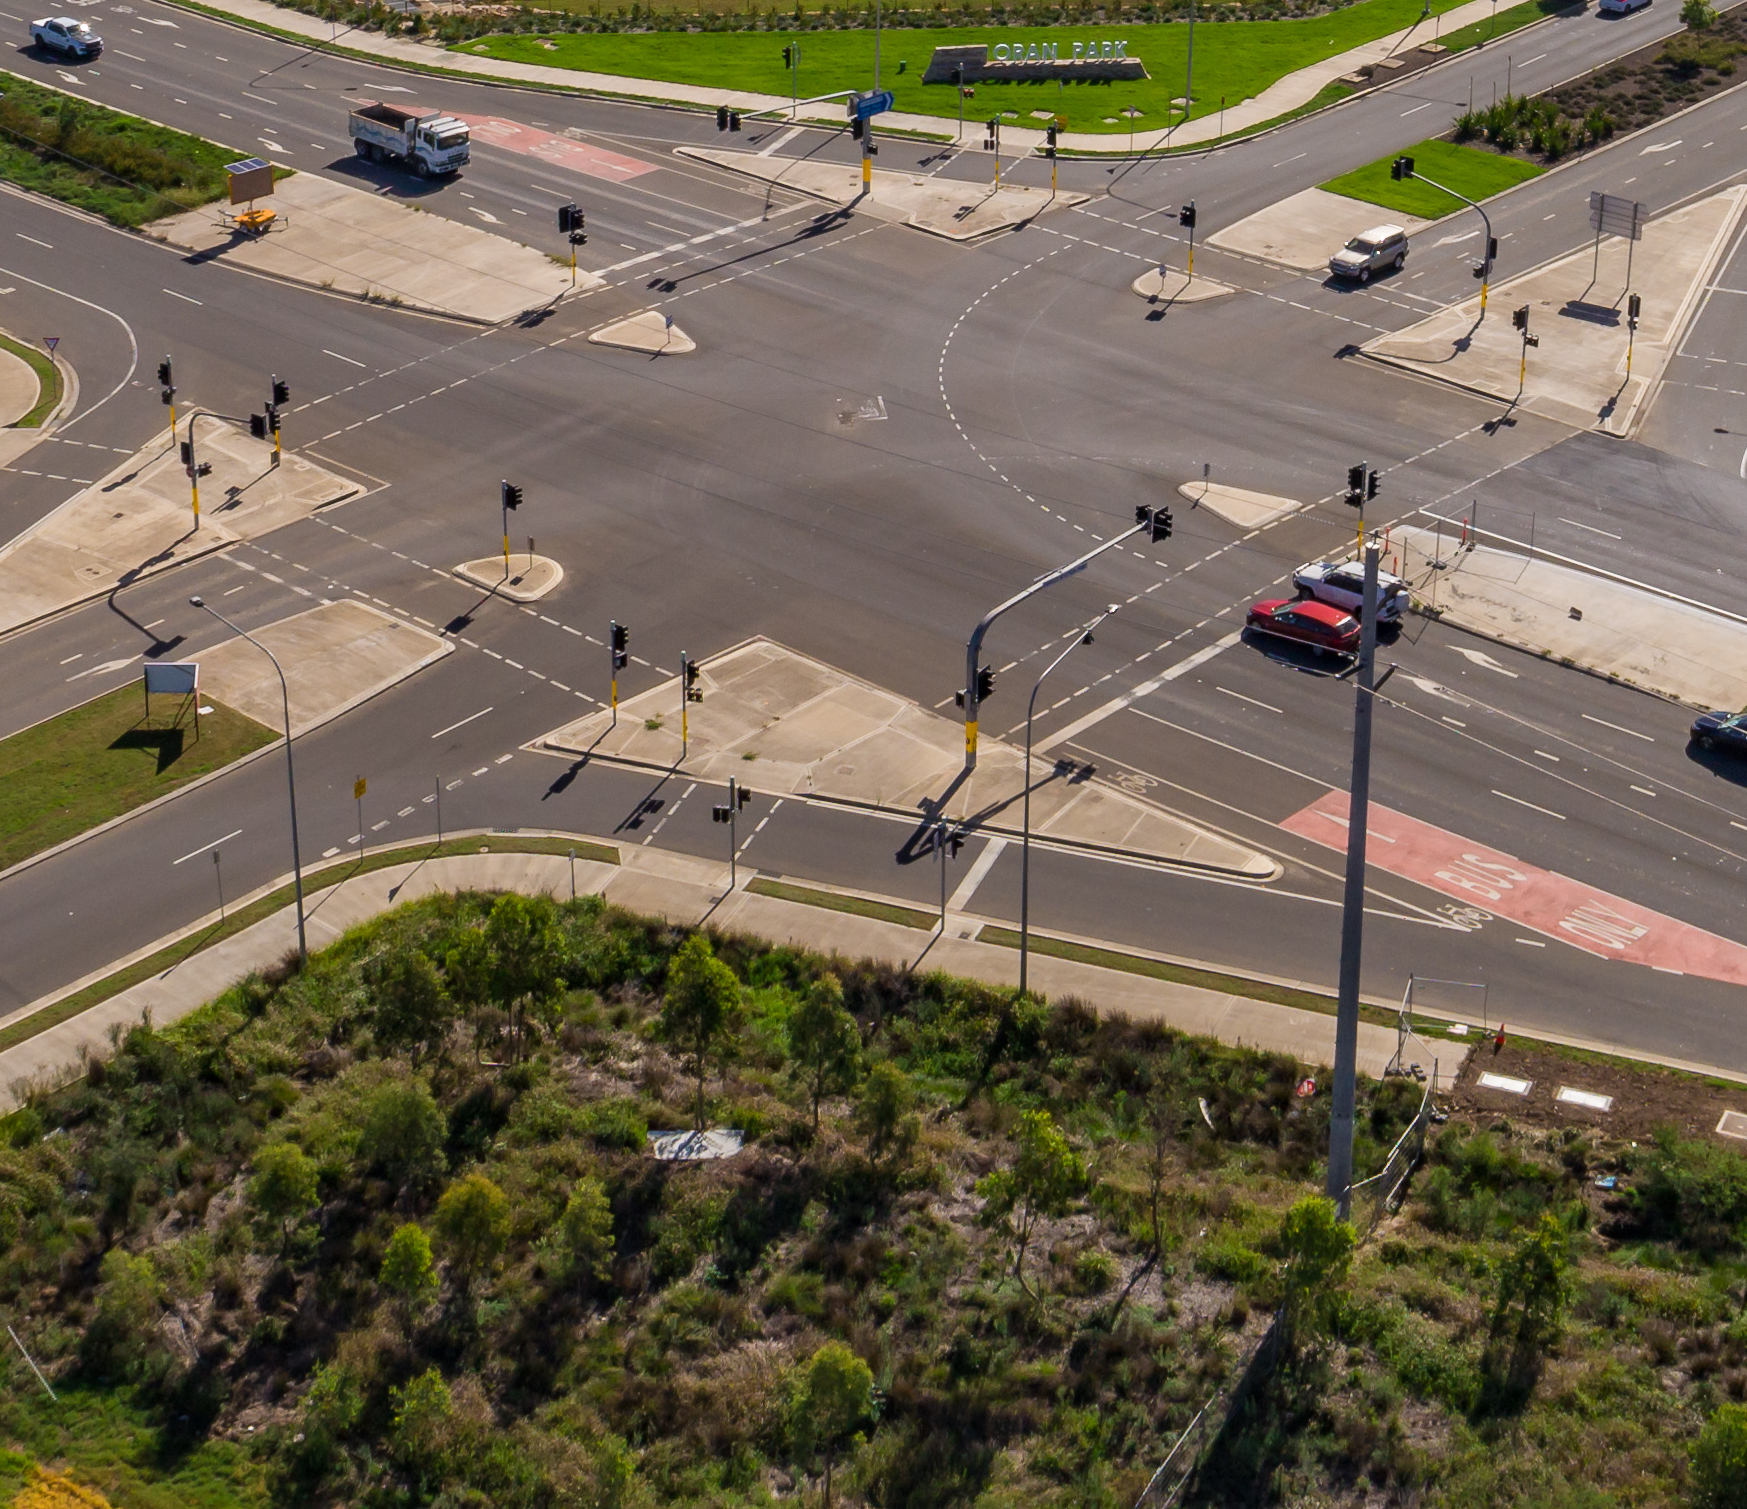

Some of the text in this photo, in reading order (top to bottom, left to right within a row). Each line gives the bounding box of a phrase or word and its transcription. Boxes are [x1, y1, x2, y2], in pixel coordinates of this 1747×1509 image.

[993, 41, 1128, 62] ORAN PARK
[528, 139, 584, 159] BUS
[1434, 853, 1528, 900] BUS
[1558, 898, 1651, 950] ONLY
